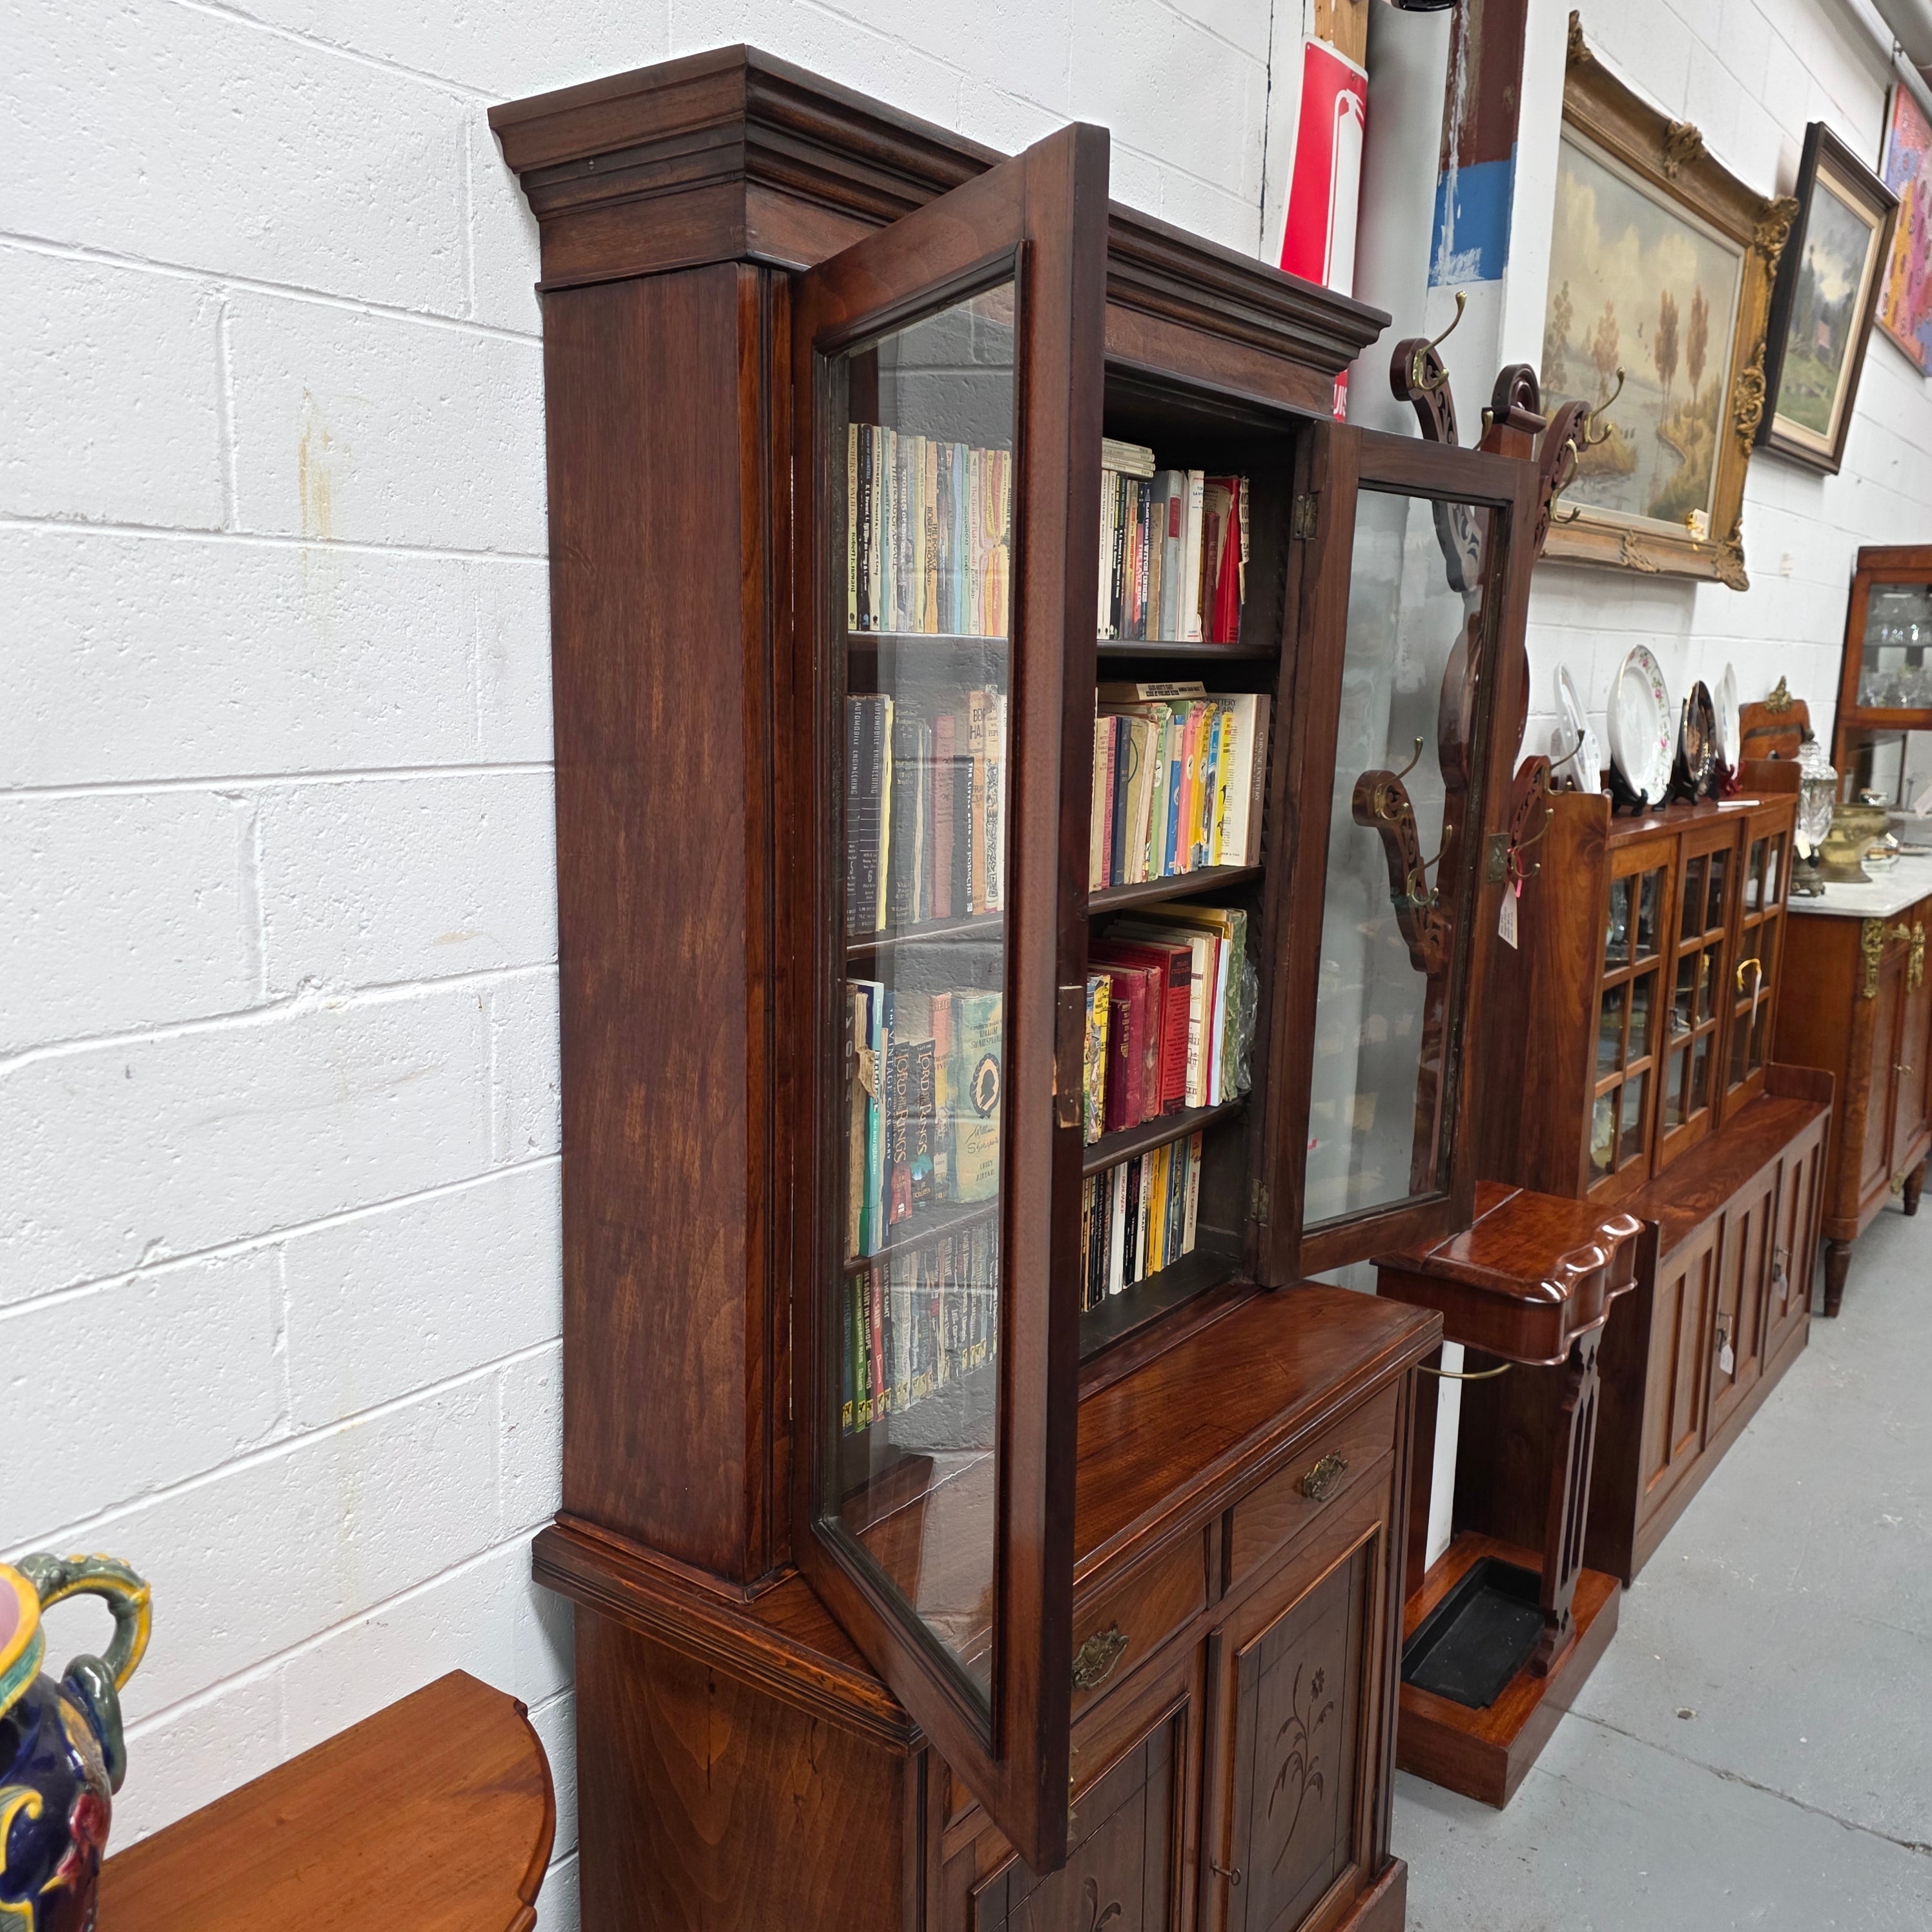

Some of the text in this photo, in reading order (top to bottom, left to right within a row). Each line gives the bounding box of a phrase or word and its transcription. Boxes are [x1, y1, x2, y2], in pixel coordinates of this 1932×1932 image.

[850, 475, 856, 485] OF
[850, 750, 859, 794] ENGINEERING
[870, 750, 879, 794] ENGINEERING
[967, 838, 971, 848] OF
[868, 870, 873, 882] 6
[979, 1027, 998, 1038] WILLIAM
[886, 1031, 894, 1093] VINTAGE
[894, 1053, 909, 1095] LORD
[918, 1051, 932, 1092] LORD
[894, 1107, 909, 1164] RINGS
[917, 1104, 931, 1156] RINGS
[976, 1169, 995, 1182] LIBRARY
[979, 1160, 993, 1170] ABBEY
